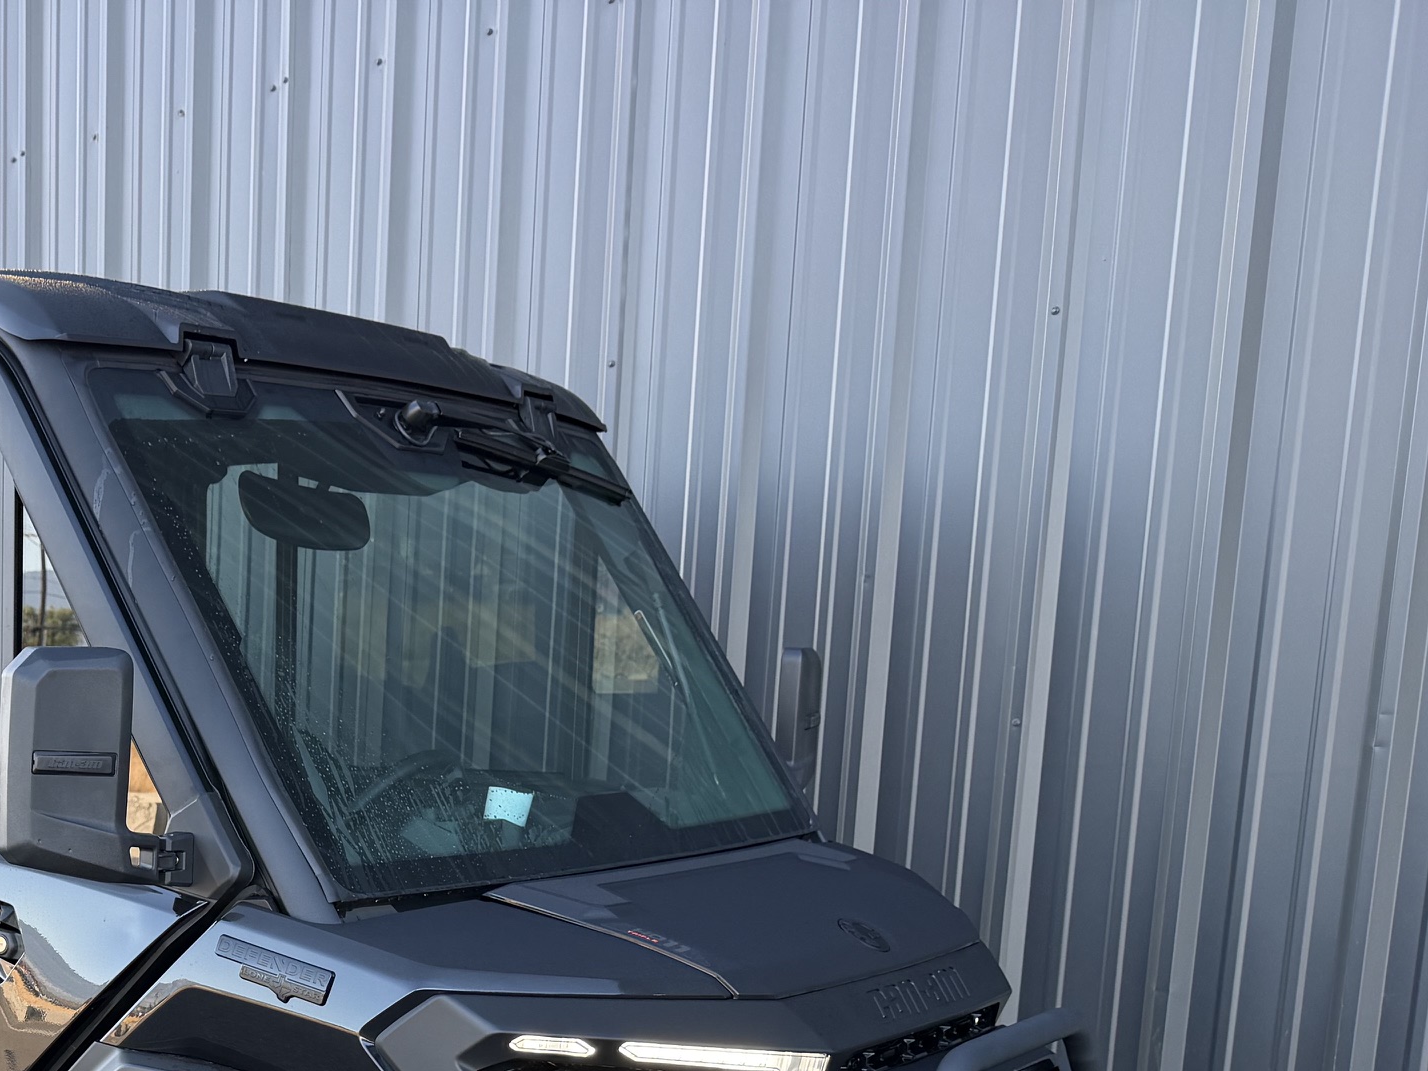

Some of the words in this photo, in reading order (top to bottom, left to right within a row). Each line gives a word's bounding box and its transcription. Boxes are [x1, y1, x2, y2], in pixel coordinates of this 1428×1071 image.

[218, 940, 327, 987] DEFENDER
[243, 966, 271, 984] LONE
[866, 965, 971, 1019] can-am
